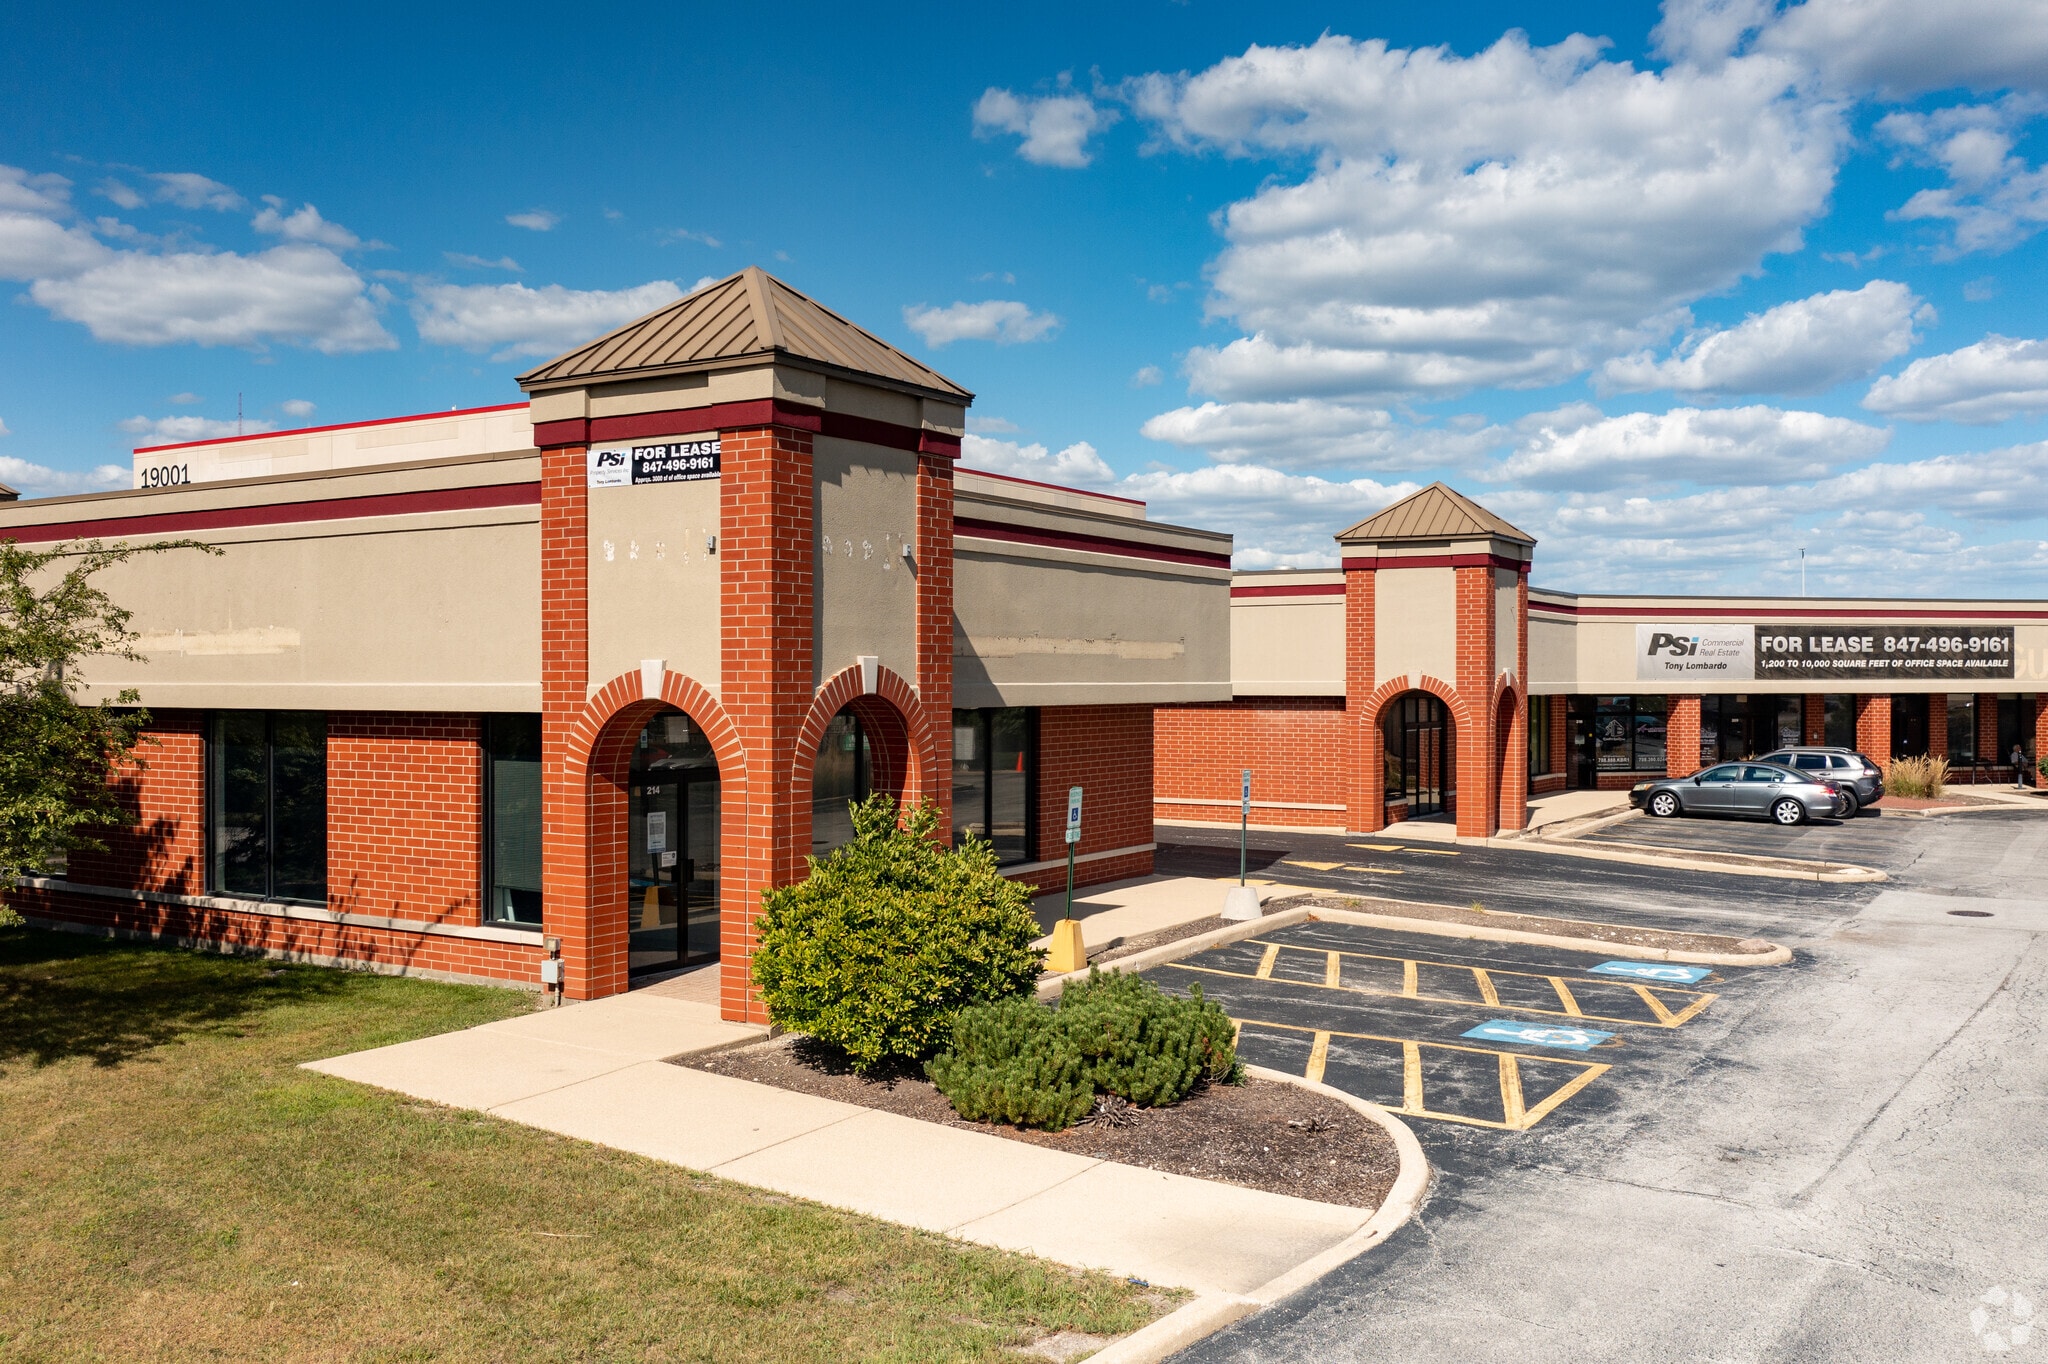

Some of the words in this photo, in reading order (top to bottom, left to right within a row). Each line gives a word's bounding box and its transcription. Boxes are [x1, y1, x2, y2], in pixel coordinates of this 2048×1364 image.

[635, 446, 666, 460] FOR
[671, 442, 721, 457] LEASE
[643, 457, 713, 473] 847-496-9161
[141, 463, 191, 488] 19001
[1701, 638, 1744, 647] Commercial
[1761, 636, 1802, 652] FOR
[1809, 636, 1874, 652] LEASE
[1883, 636, 2009, 652] 847-496-9161
[1717, 649, 1740, 657] Estate
[1664, 662, 1683, 671] Tony
[1686, 662, 1727, 670] Lombardo
[1761, 660, 1785, 669] 1,200
[1801, 660, 1830, 669] 10,000
[1832, 660, 1866, 668] SQUARE
[646, 786, 660, 795] 214
